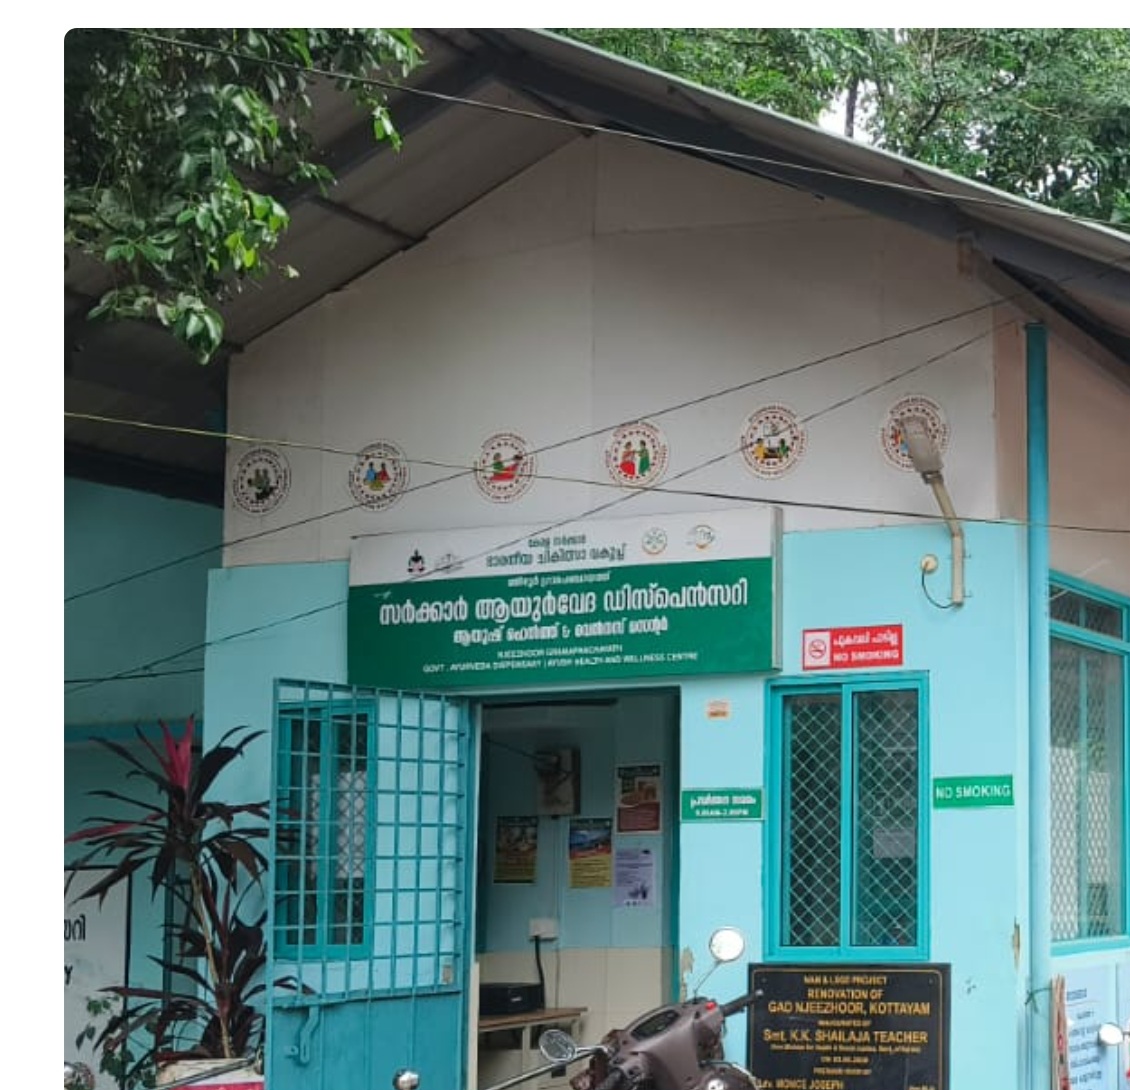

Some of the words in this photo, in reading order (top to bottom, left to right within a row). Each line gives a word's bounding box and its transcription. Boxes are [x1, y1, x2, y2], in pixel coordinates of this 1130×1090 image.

[379, 595, 468, 625] സർക്കാർ
[475, 590, 596, 623] ആയുർവേദ
[453, 625, 505, 647] ആയുഷ്
[833, 653, 848, 662] NO
[851, 649, 899, 661] SMOKING
[936, 786, 953, 799] NO
[956, 785, 1011, 799] SMOKING
[808, 989, 868, 999] RENOVATION
[870, 989, 884, 999] OF
[869, 1002, 930, 1016] KOTTAYAM
[815, 1030, 871, 1042] SHAILAJA
[874, 1031, 928, 1043] TEACHER
